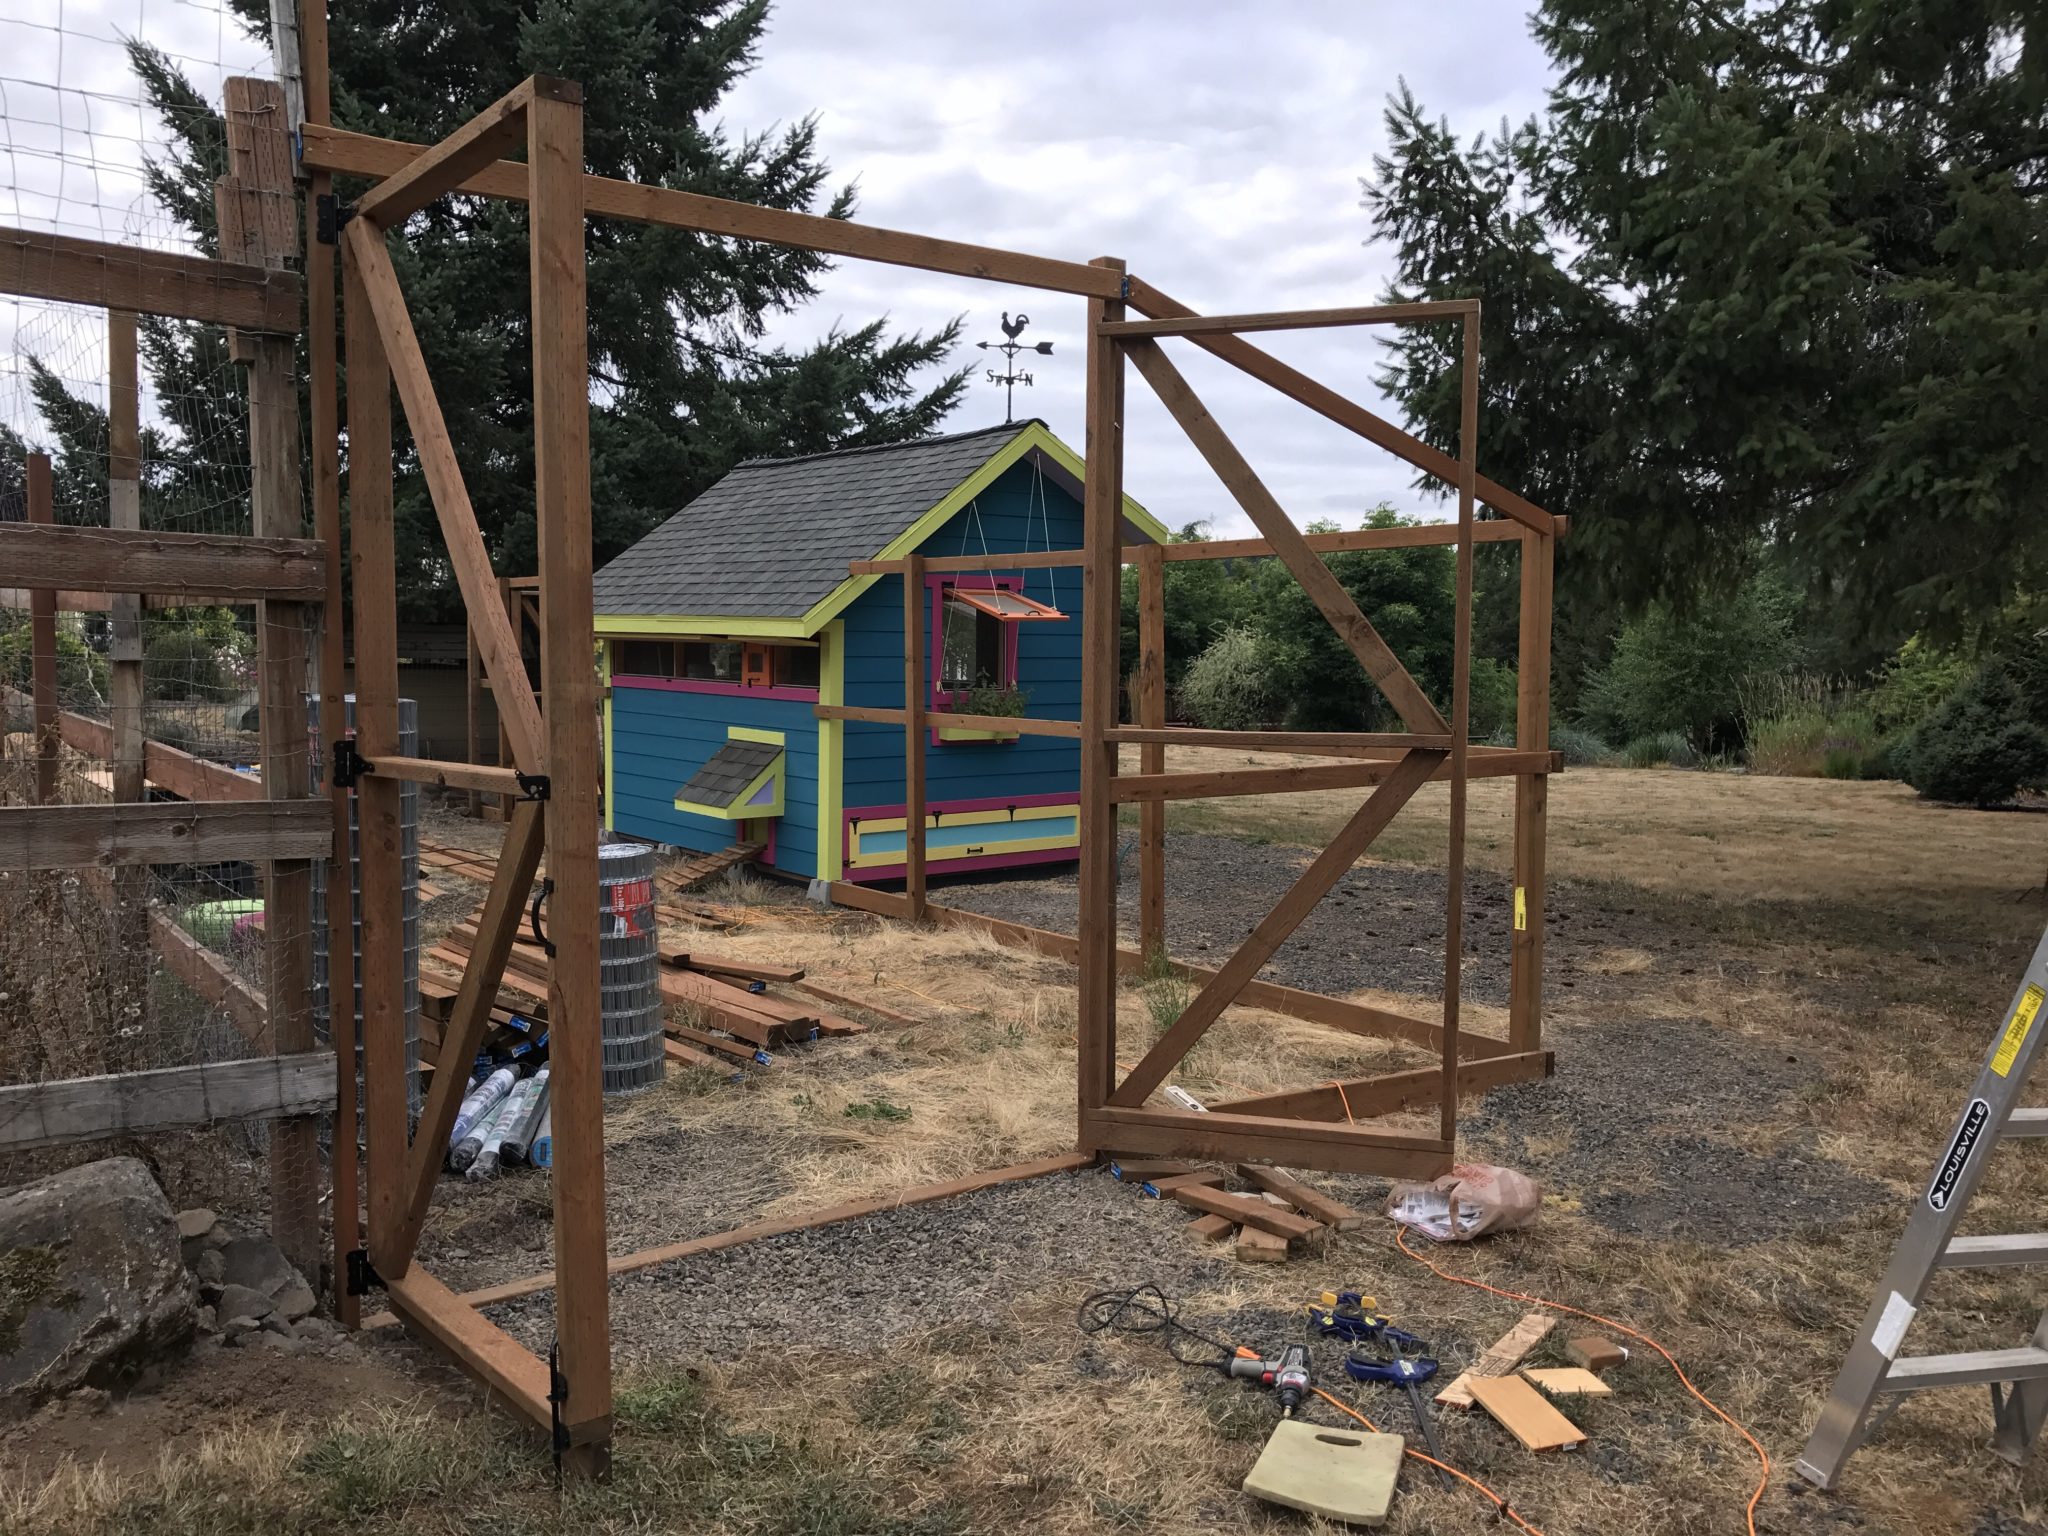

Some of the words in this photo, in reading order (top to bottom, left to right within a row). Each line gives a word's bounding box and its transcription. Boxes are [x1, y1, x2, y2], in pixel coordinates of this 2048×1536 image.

[986, 369, 994, 382] S
[1025, 373, 1033, 387] N
[1940, 1103, 1986, 1192] LOUISVILLE
